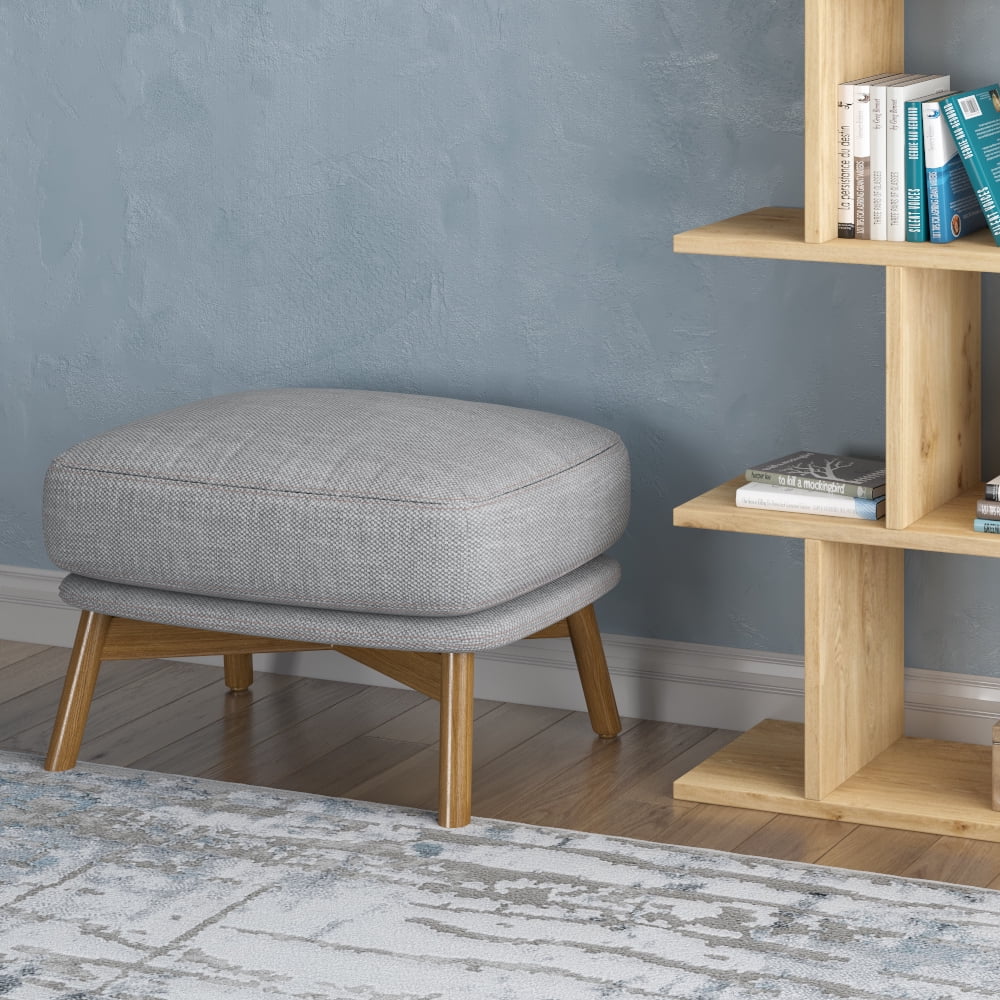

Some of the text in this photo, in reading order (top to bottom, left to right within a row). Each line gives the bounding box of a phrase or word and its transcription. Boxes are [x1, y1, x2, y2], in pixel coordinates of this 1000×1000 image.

[838, 126, 851, 146] destin
[838, 149, 851, 158] du
[838, 160, 853, 199] persistance
[838, 202, 851, 210] La
[976, 186, 996, 212] VOICES
[907, 188, 921, 233] SILENT VOICES
[778, 475, 846, 494] to kill a mockingbird
